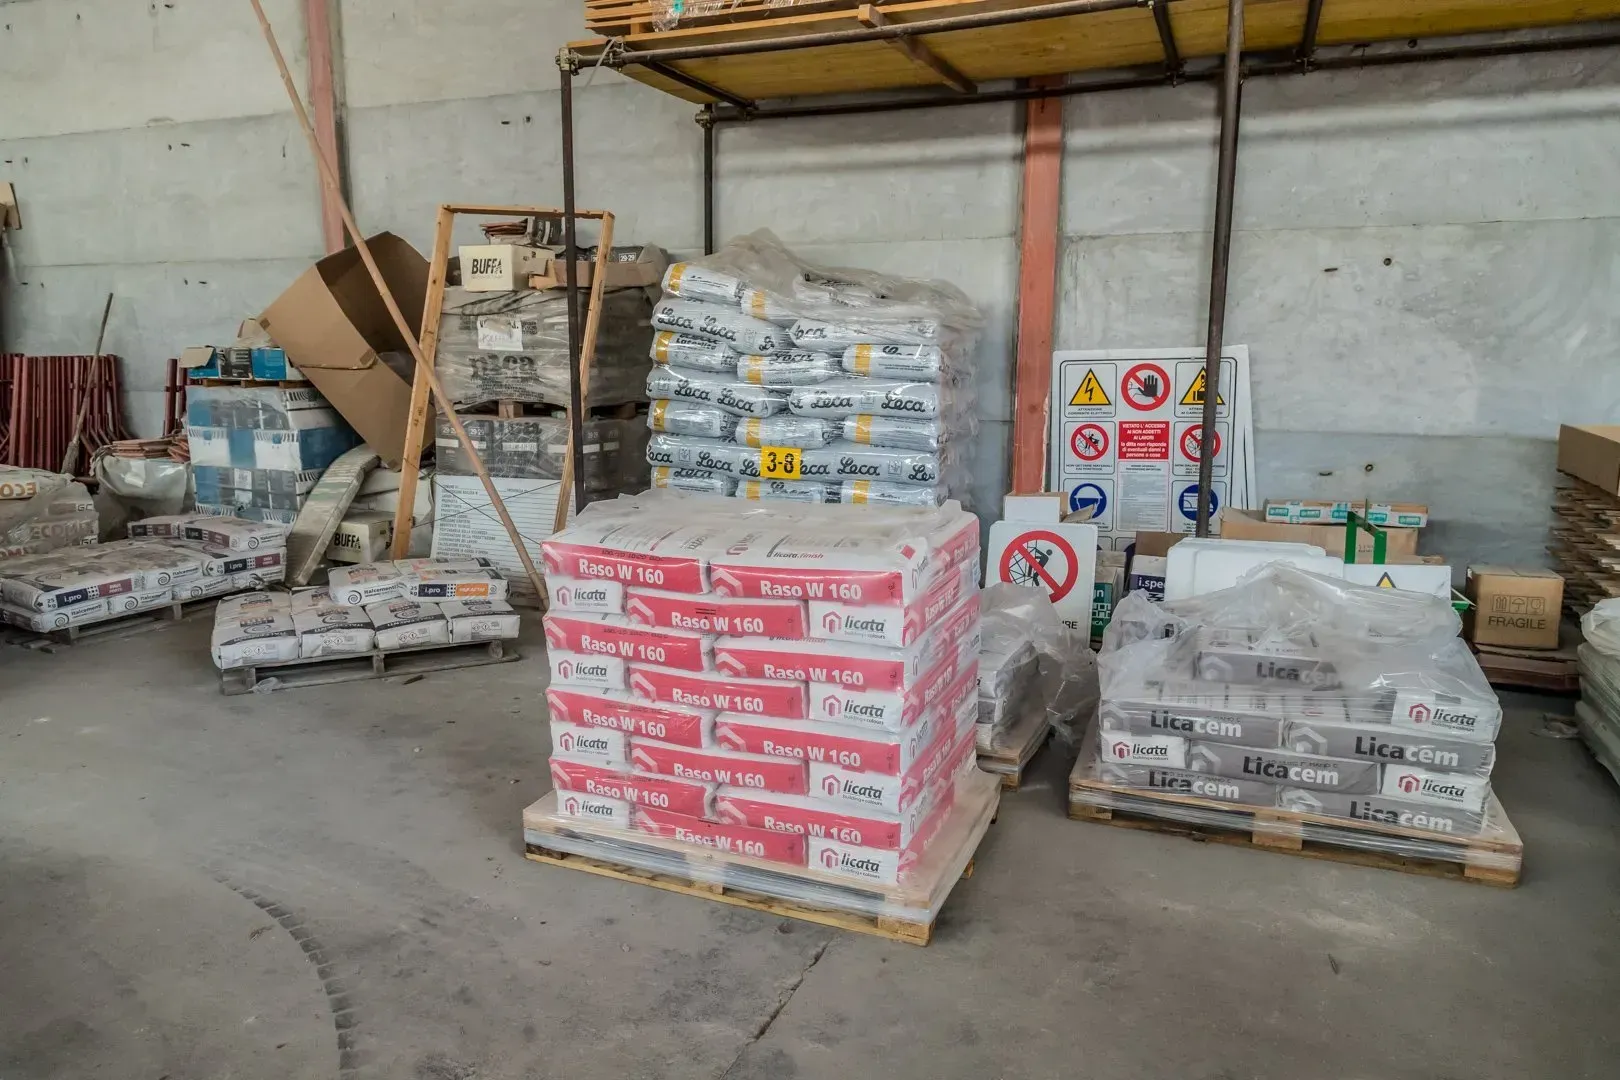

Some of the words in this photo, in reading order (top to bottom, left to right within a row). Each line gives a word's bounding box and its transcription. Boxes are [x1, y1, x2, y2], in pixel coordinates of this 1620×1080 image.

[471, 258, 503, 275] BUFFA
[657, 307, 694, 329] Leca
[700, 316, 737, 342] Leca
[674, 379, 711, 401] Leca
[717, 388, 754, 413] Leca
[811, 391, 853, 408] Leca
[881, 390, 925, 412] Leca
[696, 451, 733, 472] Leca
[767, 452, 794, 473] 3-8
[837, 456, 881, 476] Leca
[579, 559, 615, 577] Raso
[616, 564, 633, 580] W
[637, 568, 664, 585] 160
[64, 594, 82, 603] i.pro
[424, 585, 441, 595] i.pro
[574, 588, 608, 602] licata
[760, 580, 803, 598] Raso
[805, 582, 824, 599] W
[829, 583, 862, 600] 160
[671, 611, 711, 630] Raso
[713, 617, 729, 632] W
[734, 618, 763, 633] 160
[844, 615, 886, 632] licata
[1062, 621, 1078, 629] RE
[1488, 616, 1547, 630] FRAGILE
[581, 635, 616, 655] Raso
[619, 641, 634, 657] W
[638, 646, 665, 663] 160
[575, 662, 608, 677] licata
[763, 664, 806, 680] Raso
[809, 667, 827, 683] W
[831, 670, 864, 686] 160
[672, 688, 711, 707] Raso
[713, 694, 730, 709] W
[734, 697, 763, 713] 160
[844, 699, 885, 718] licata
[583, 709, 618, 728] Raso
[620, 716, 635, 732] W
[639, 721, 666, 738] 160
[1151, 710, 1242, 738] Licacem
[1433, 708, 1477, 727] licata
[577, 735, 609, 750] licata
[1132, 743, 1168, 756] licata
[1355, 736, 1459, 767] Licacem
[763, 740, 804, 758] Raso
[807, 746, 825, 762] W
[829, 749, 861, 767] 160
[673, 763, 712, 781] Raso
[714, 769, 731, 784] W
[735, 772, 765, 788] 160
[1243, 756, 1340, 785] Licacem
[586, 779, 621, 798] Raso
[623, 787, 639, 803] W
[642, 791, 669, 808] 160
[843, 780, 884, 799] licata
[1149, 770, 1240, 799] Licacem
[1422, 779, 1466, 798] licata
[581, 801, 613, 816] licata
[1350, 801, 1453, 832] Licacem
[764, 816, 805, 834] Raso
[808, 823, 825, 838] W
[830, 827, 862, 845] 160
[715, 835, 731, 850] W
[736, 840, 764, 857] 160
[842, 852, 881, 872] licata
